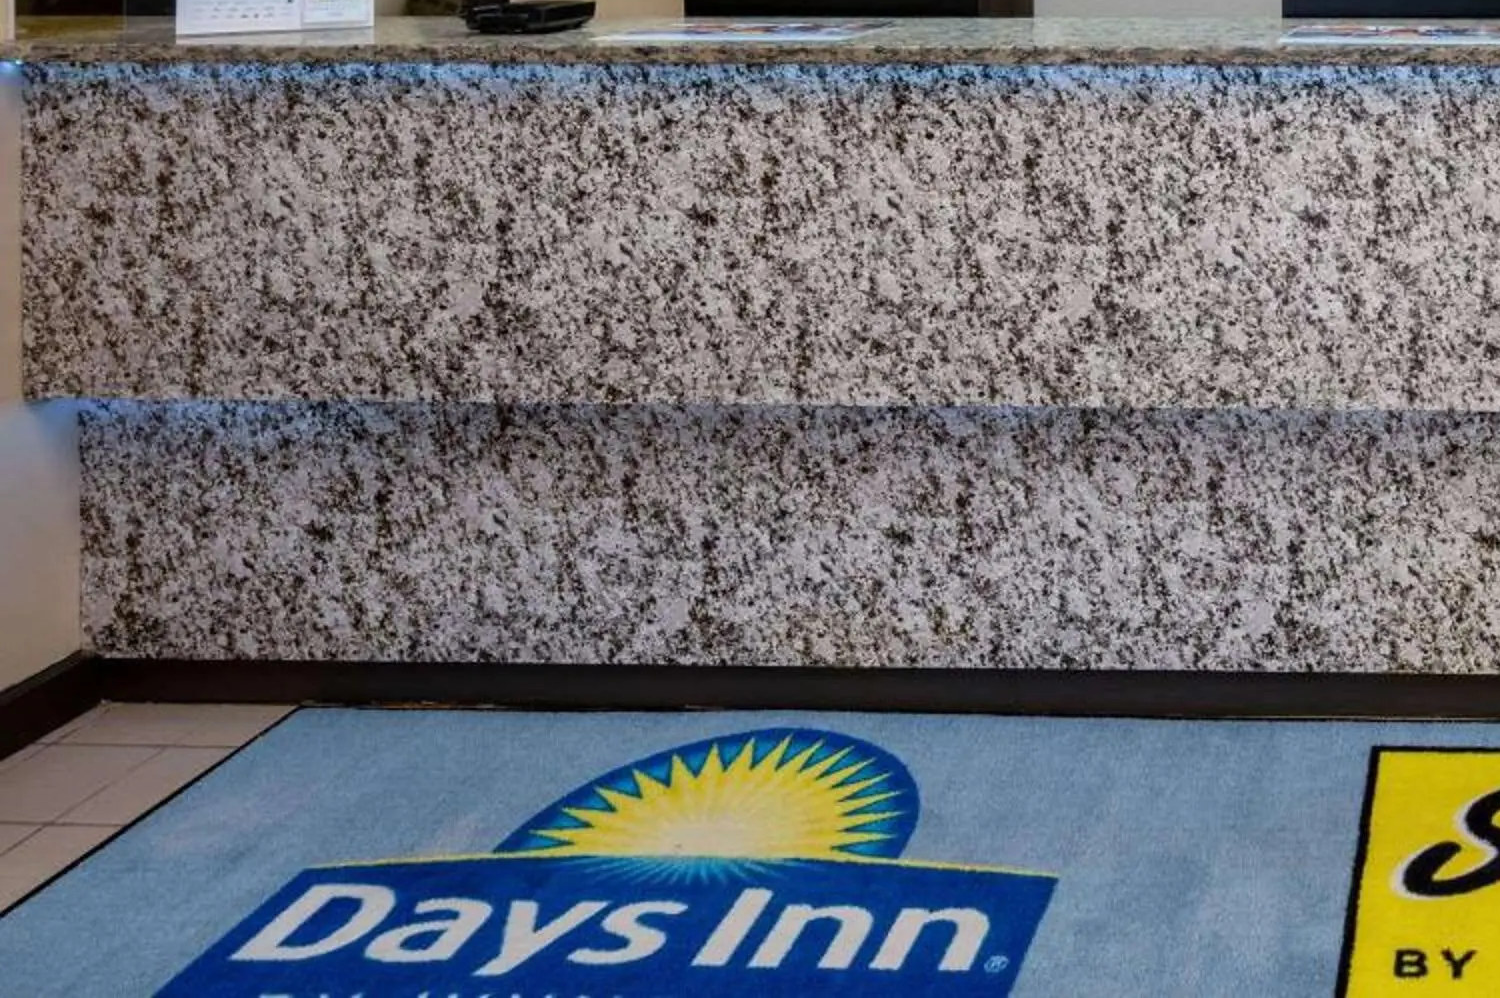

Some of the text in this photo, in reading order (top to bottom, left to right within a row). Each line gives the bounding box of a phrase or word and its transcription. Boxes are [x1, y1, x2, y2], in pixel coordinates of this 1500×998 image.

[230, 883, 990, 977] Days Inn
[1393, 948, 1477, 980] BY
